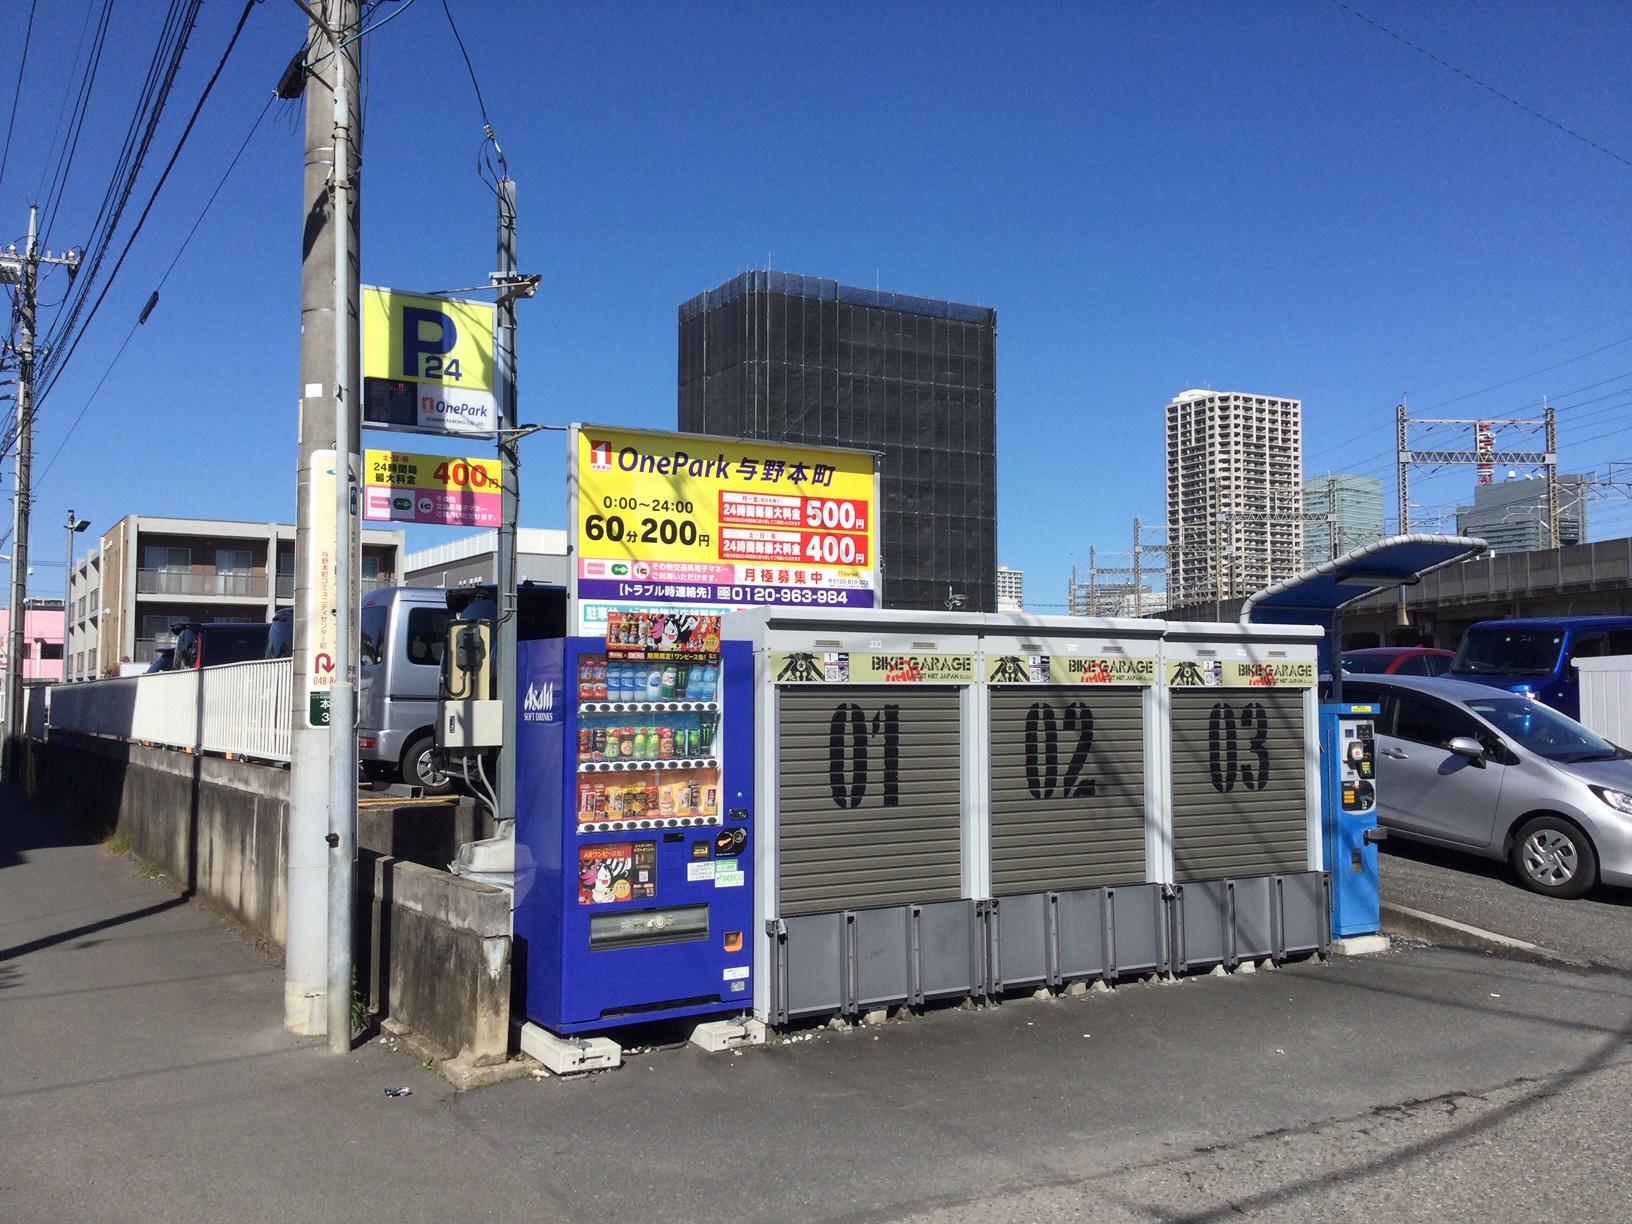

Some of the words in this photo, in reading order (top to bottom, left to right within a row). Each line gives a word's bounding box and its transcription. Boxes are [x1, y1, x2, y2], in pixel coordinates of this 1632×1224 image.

[403, 306, 458, 378] P
[423, 355, 462, 382] 24
[436, 401, 488, 417] OnePark
[373, 462, 418, 475] 24時間毎
[618, 447, 729, 480] OnePark
[736, 456, 835, 486] 与野本町
[375, 473, 417, 485] 最大料金
[744, 568, 823, 584] 月極募集中
[732, 587, 848, 604] 0120-963-984
[872, 656, 904, 671] BIKE
[908, 656, 971, 672] GARAGE
[1069, 659, 1096, 673] BIKE
[1099, 660, 1153, 674] GARAGE
[1238, 664, 1263, 677] BIKE
[1265, 664, 1312, 677] GARAGE
[524, 681, 553, 711] Asahi
[524, 712, 535, 721] SOFT
[535, 712, 553, 721] DRINKS
[829, 702, 899, 809] 01
[1025, 702, 1095, 800] 02
[1209, 702, 1269, 793] 03
